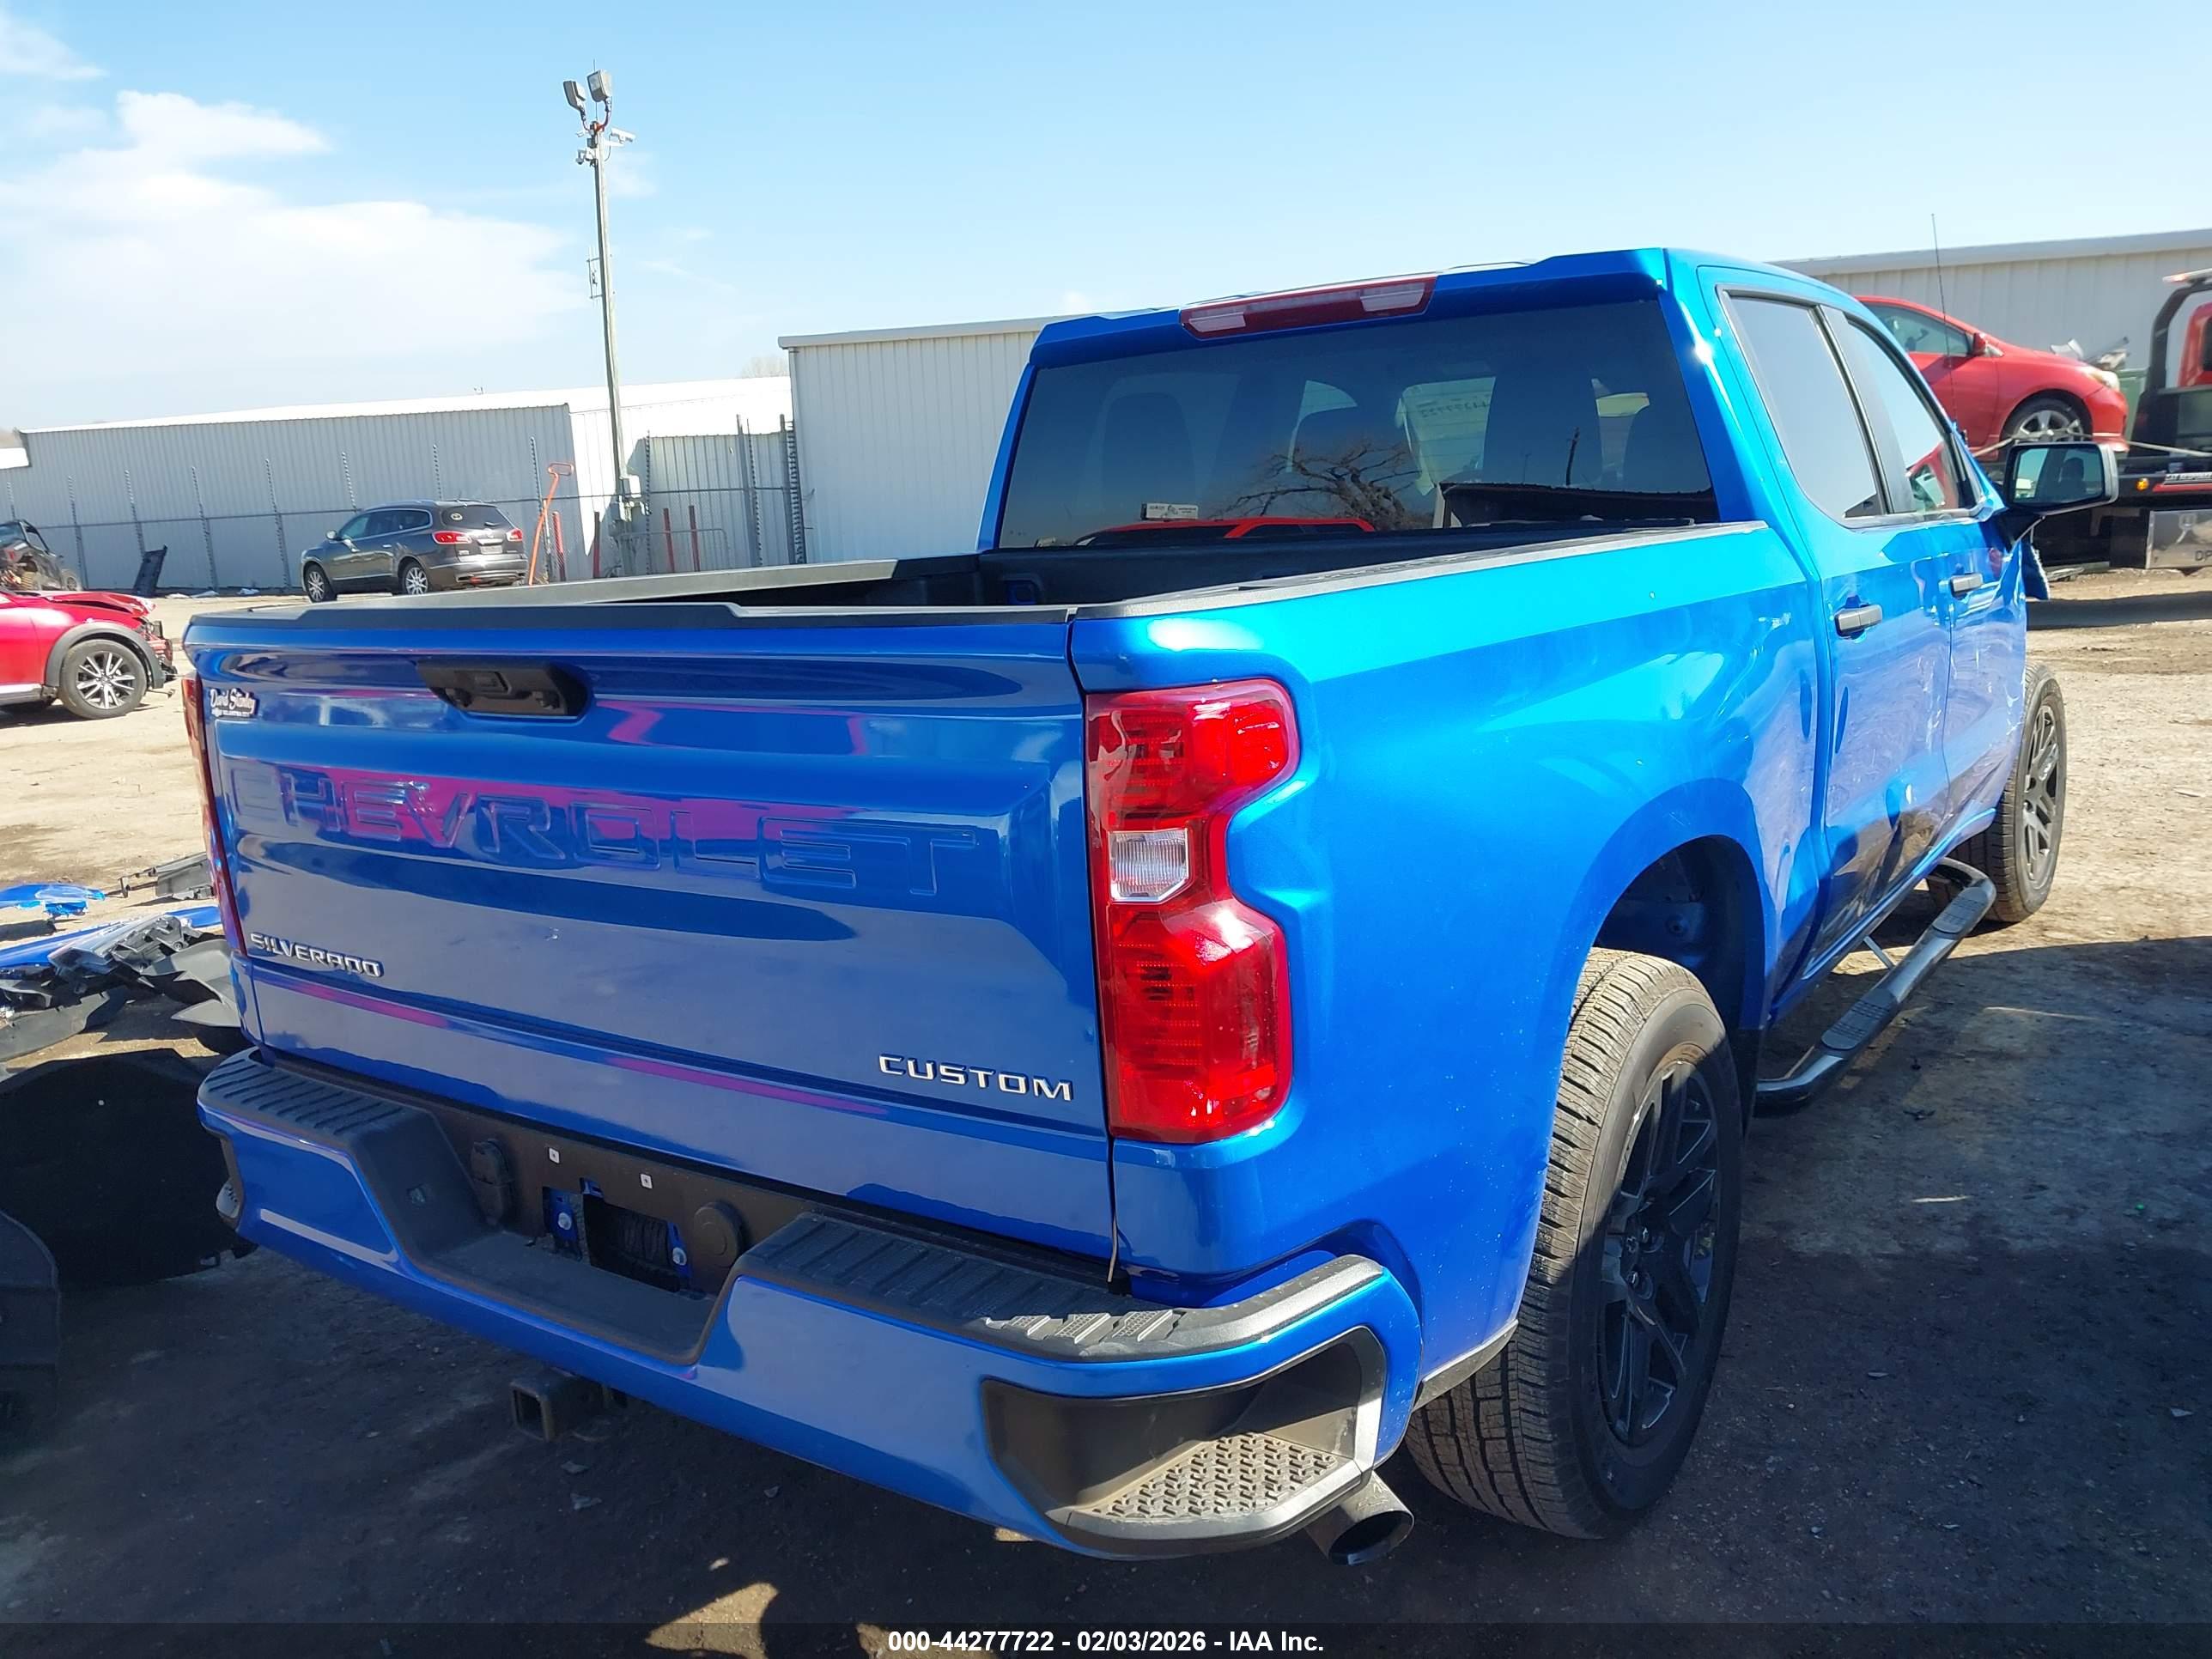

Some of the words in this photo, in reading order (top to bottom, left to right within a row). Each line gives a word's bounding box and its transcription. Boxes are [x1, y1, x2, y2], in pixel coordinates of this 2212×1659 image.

[230, 767, 978, 897] CHEVROLET
[250, 933, 383, 977] SILVERADO
[878, 1053, 1074, 1102] CUSTOM
